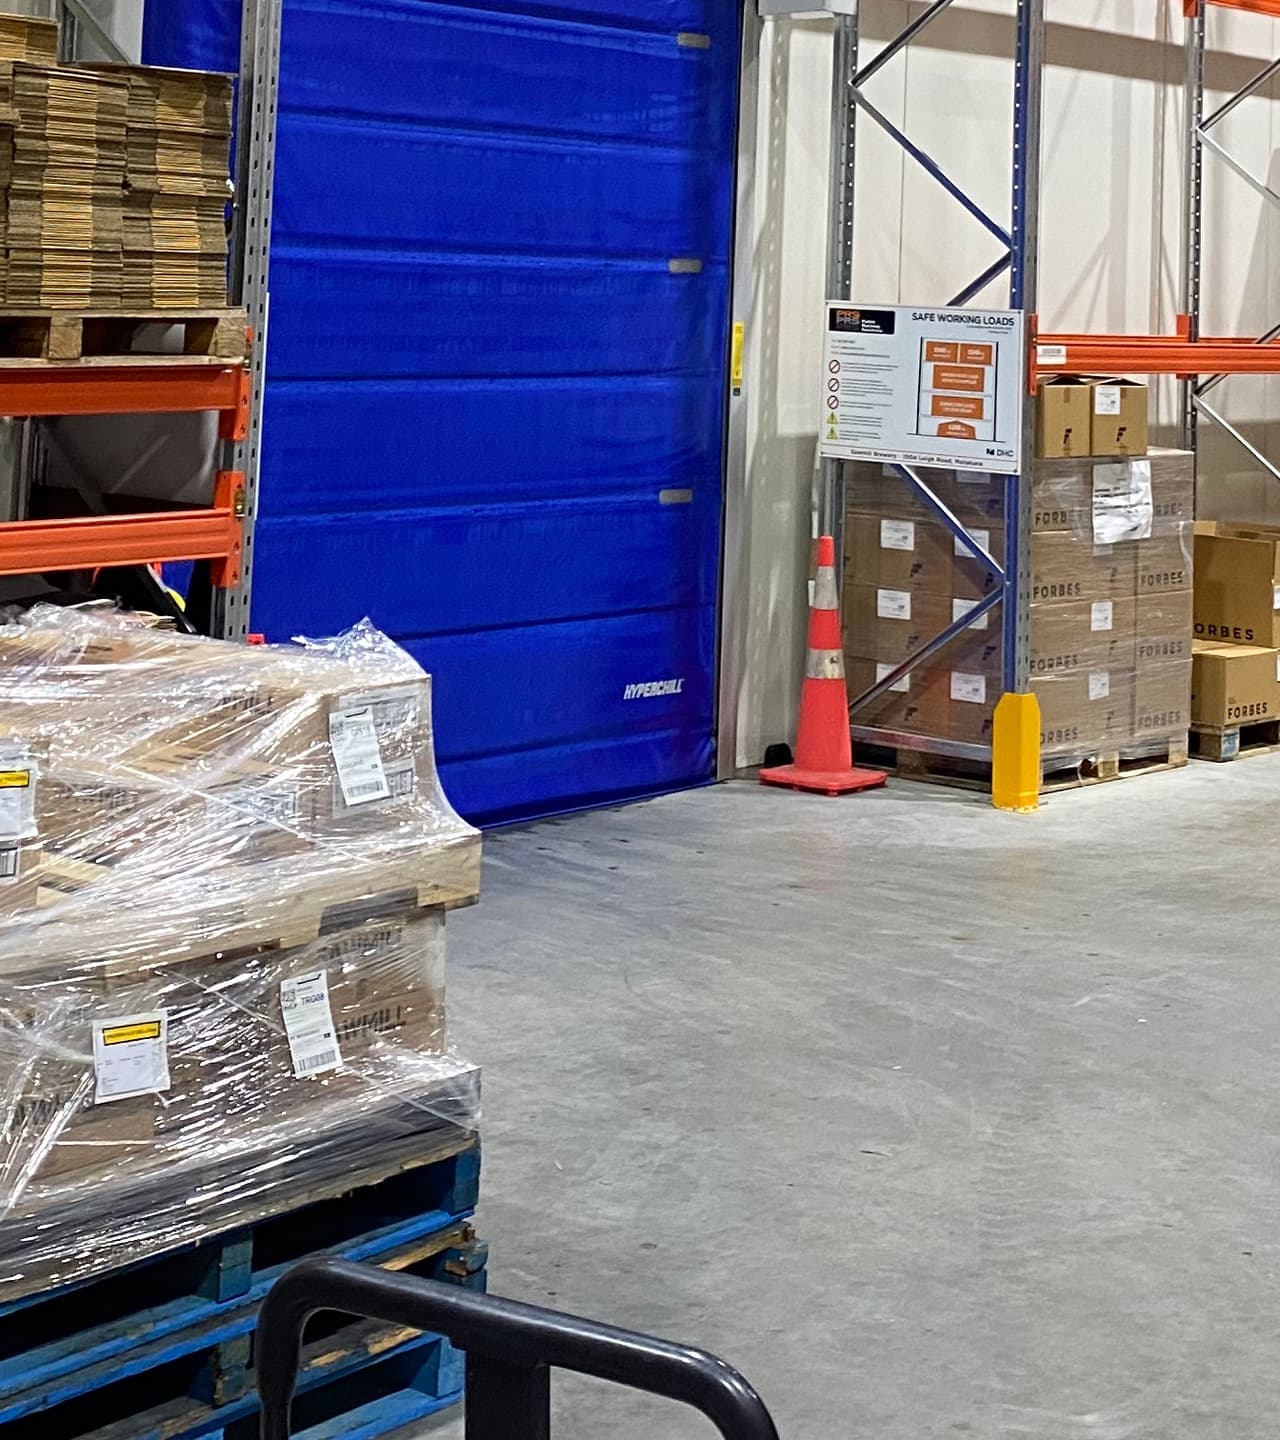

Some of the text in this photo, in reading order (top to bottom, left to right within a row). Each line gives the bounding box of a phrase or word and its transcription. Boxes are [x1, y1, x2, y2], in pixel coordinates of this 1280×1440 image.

[912, 312, 1014, 326] SAFE WORKING LOADS
[1141, 571, 1184, 587] FORBES
[1033, 582, 1081, 600] FORBES
[1193, 623, 1254, 641] ORBES
[1139, 641, 1183, 658] FORBES
[1030, 654, 1078, 672] FORBES
[623, 678, 685, 700] HYPERCHILL
[1227, 702, 1268, 720] FORBES
